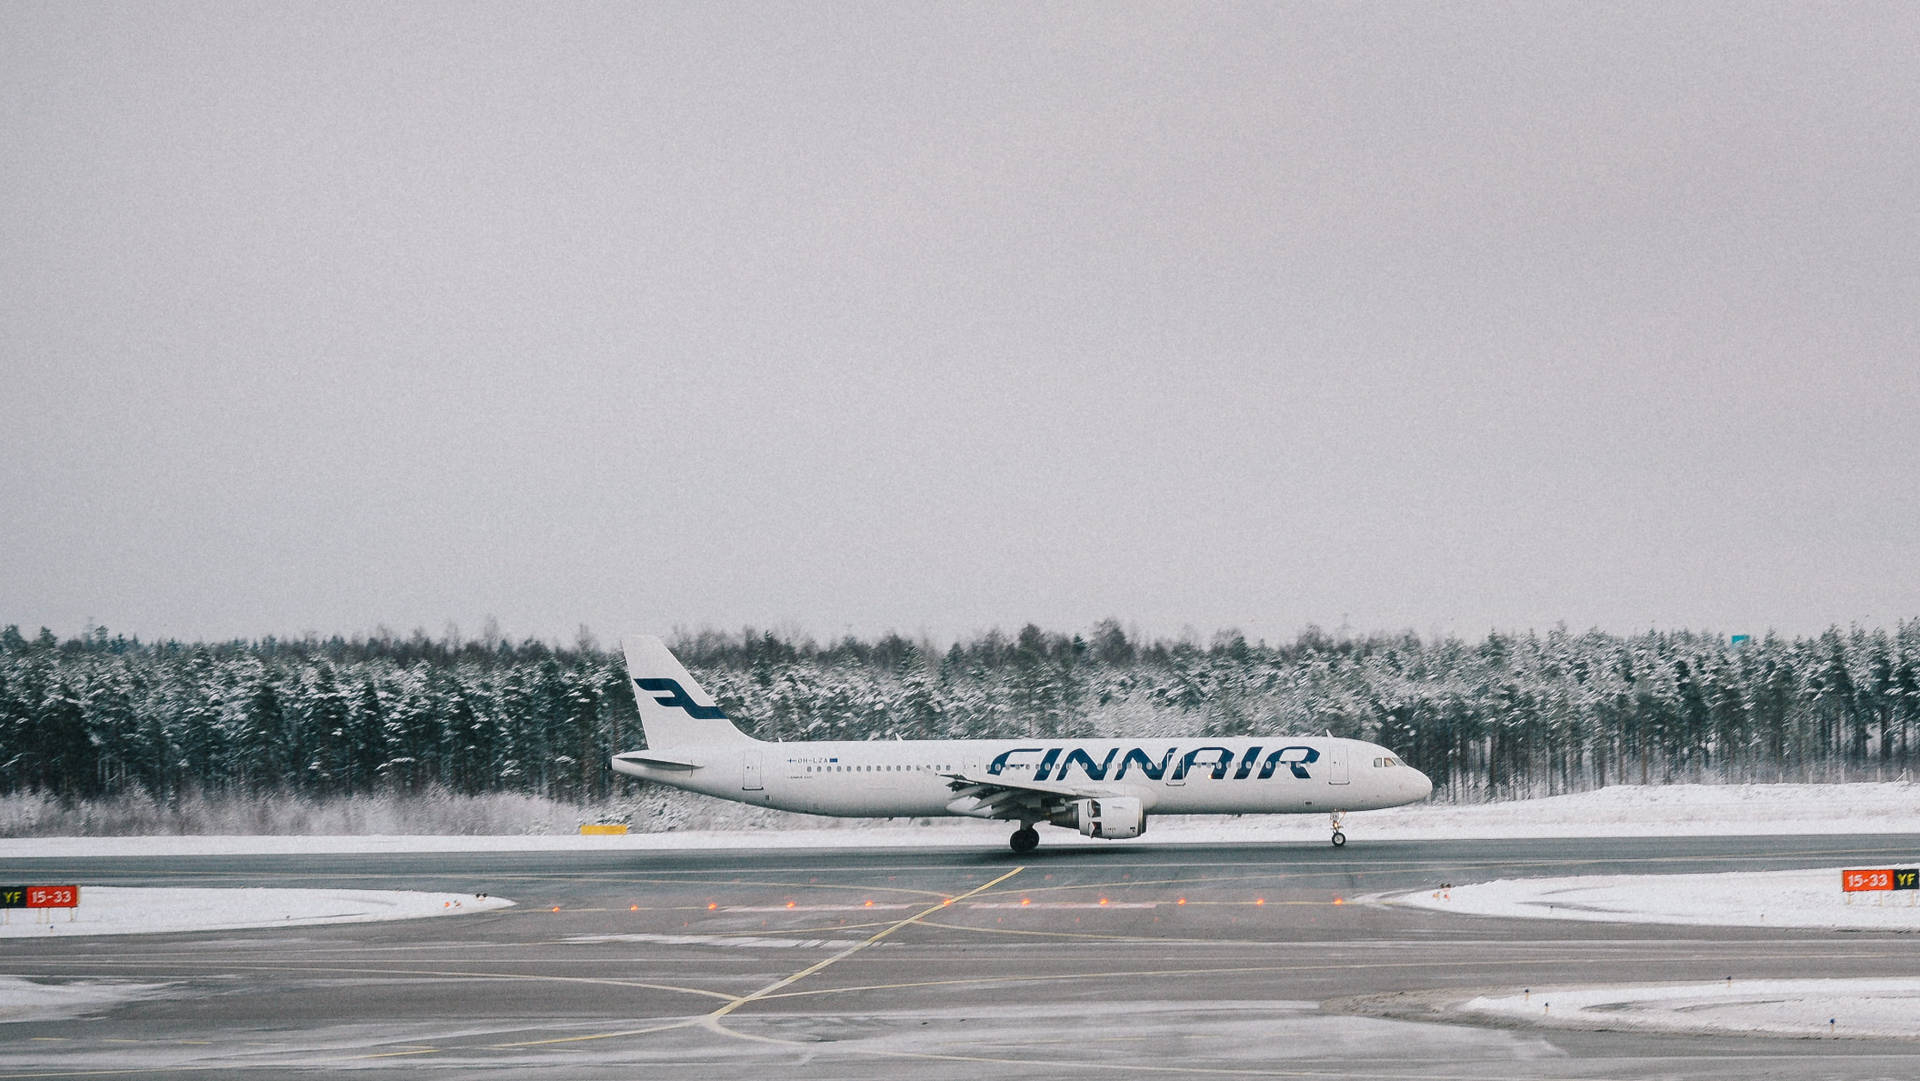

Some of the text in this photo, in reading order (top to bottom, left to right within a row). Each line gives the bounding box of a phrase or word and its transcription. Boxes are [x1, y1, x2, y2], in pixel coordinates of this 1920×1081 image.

[987, 746, 1321, 781] FINNAIR
[1848, 873, 1916, 887] 15-33 YF
[3, 890, 72, 904] YF 15-33
